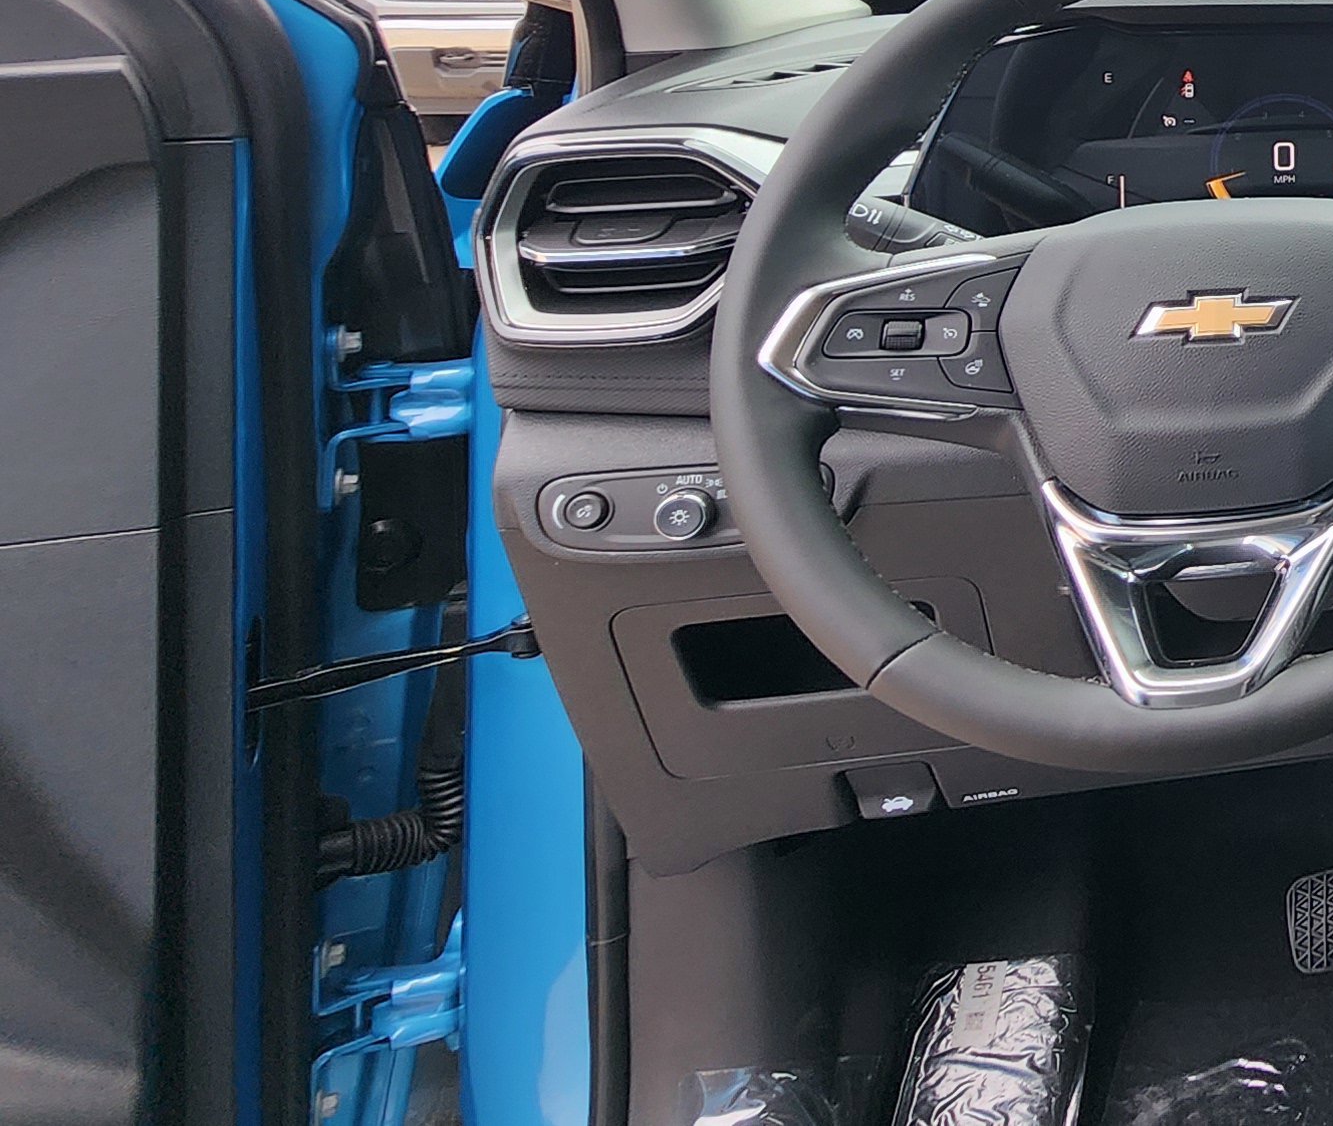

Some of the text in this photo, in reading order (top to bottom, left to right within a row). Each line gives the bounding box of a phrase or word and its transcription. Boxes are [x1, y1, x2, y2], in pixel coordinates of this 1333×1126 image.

[1104, 73, 1113, 84] E
[1273, 141, 1296, 171] 0
[1107, 175, 1115, 184] F
[1273, 174, 1296, 184] MPH
[899, 293, 916, 302] RES
[890, 368, 906, 377] SET
[675, 474, 703, 486] AUTO
[962, 788, 1019, 803] AIRBAG
[972, 965, 997, 999] 5461
